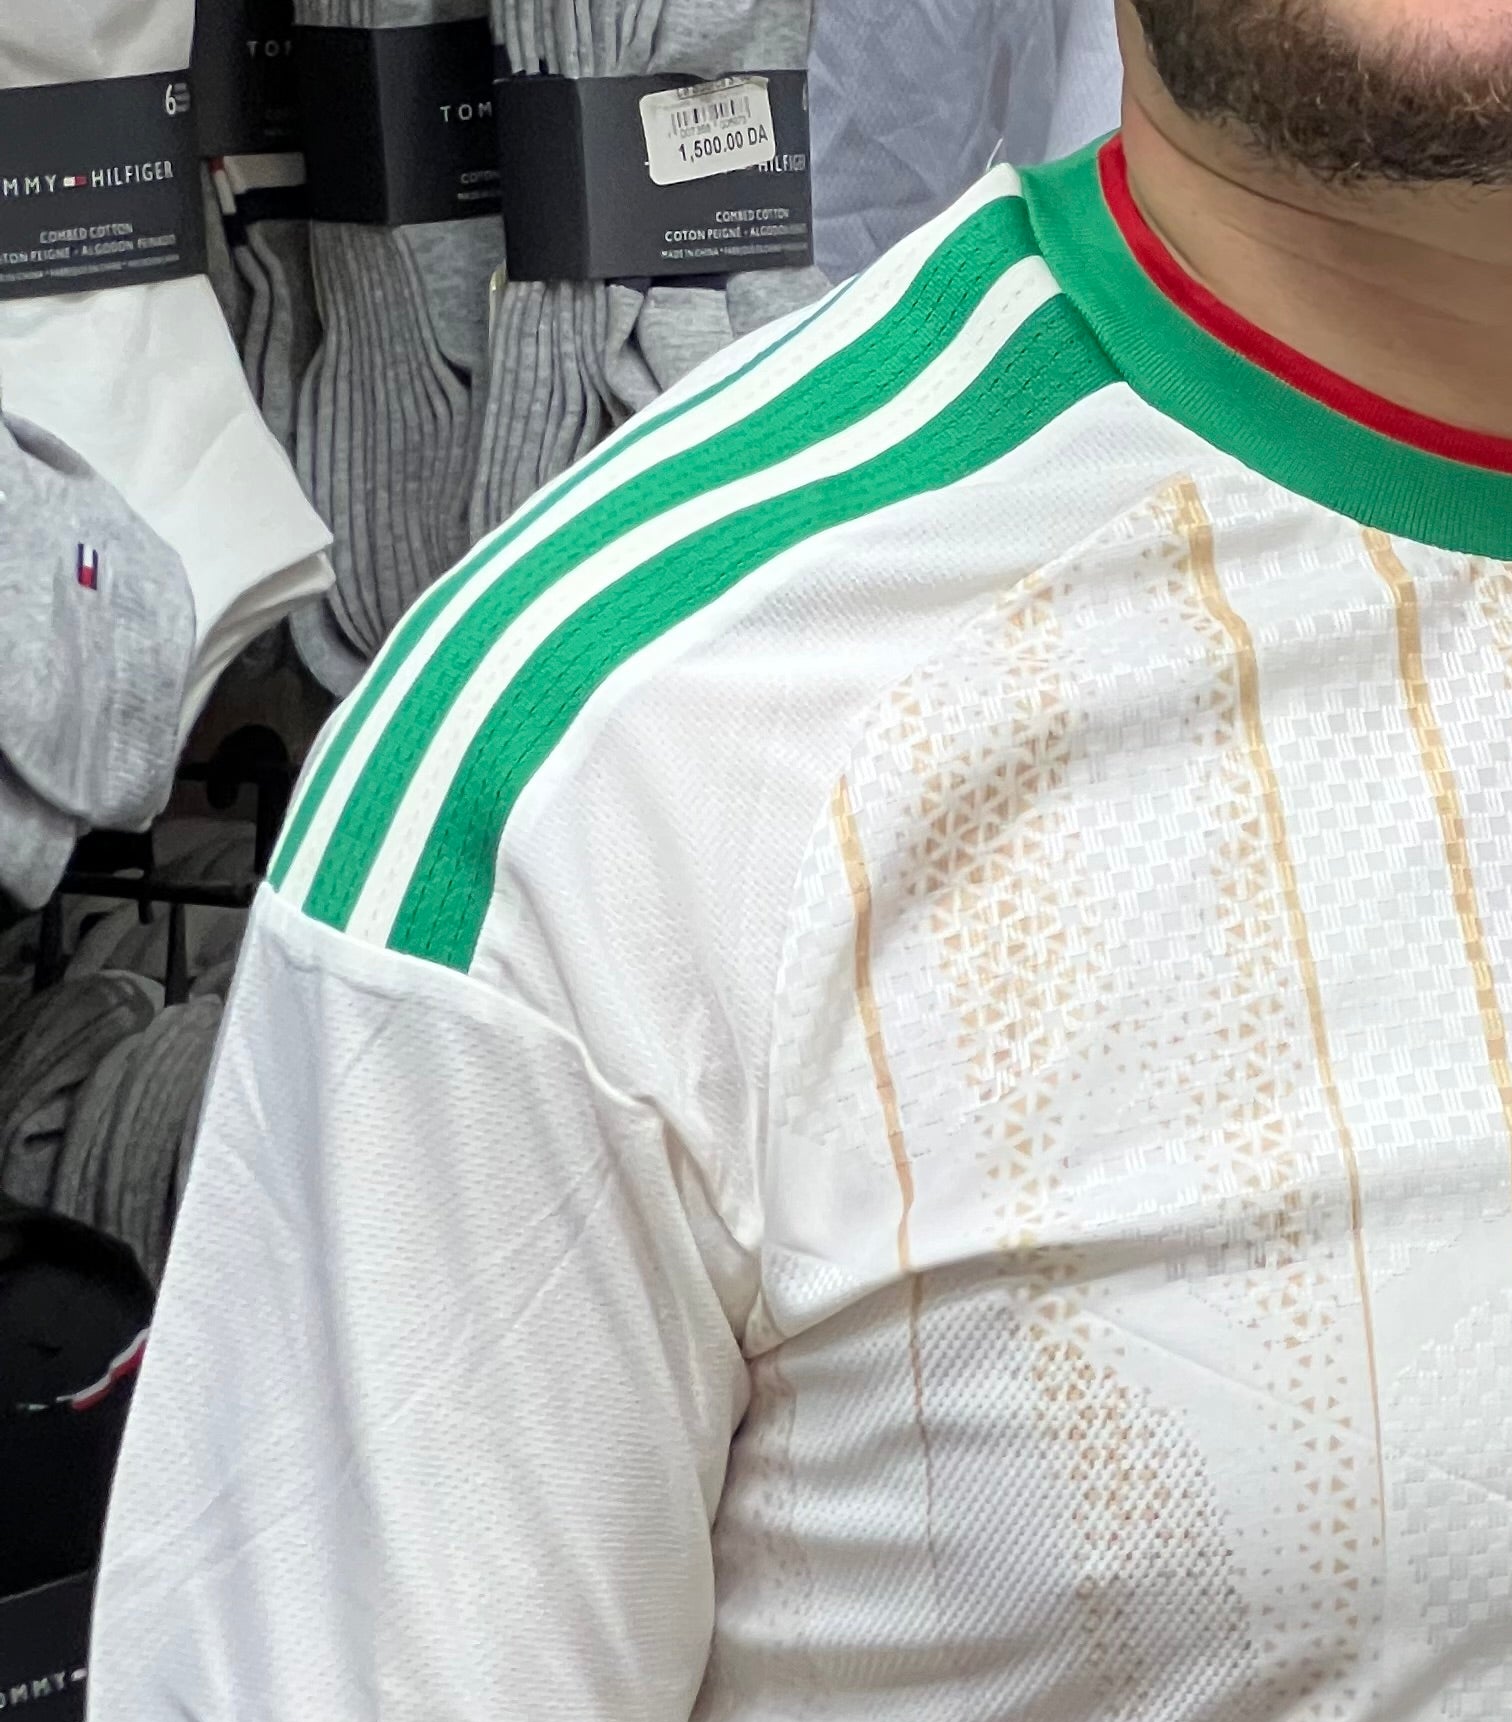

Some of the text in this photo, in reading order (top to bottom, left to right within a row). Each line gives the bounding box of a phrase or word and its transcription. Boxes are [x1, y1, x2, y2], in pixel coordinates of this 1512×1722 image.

[440, 101, 493, 122] TOM
[679, 131, 744, 163] 1,500.00
[748, 124, 769, 146] DA
[91, 160, 174, 188] HILFIGER
[664, 230, 706, 242] COTON
